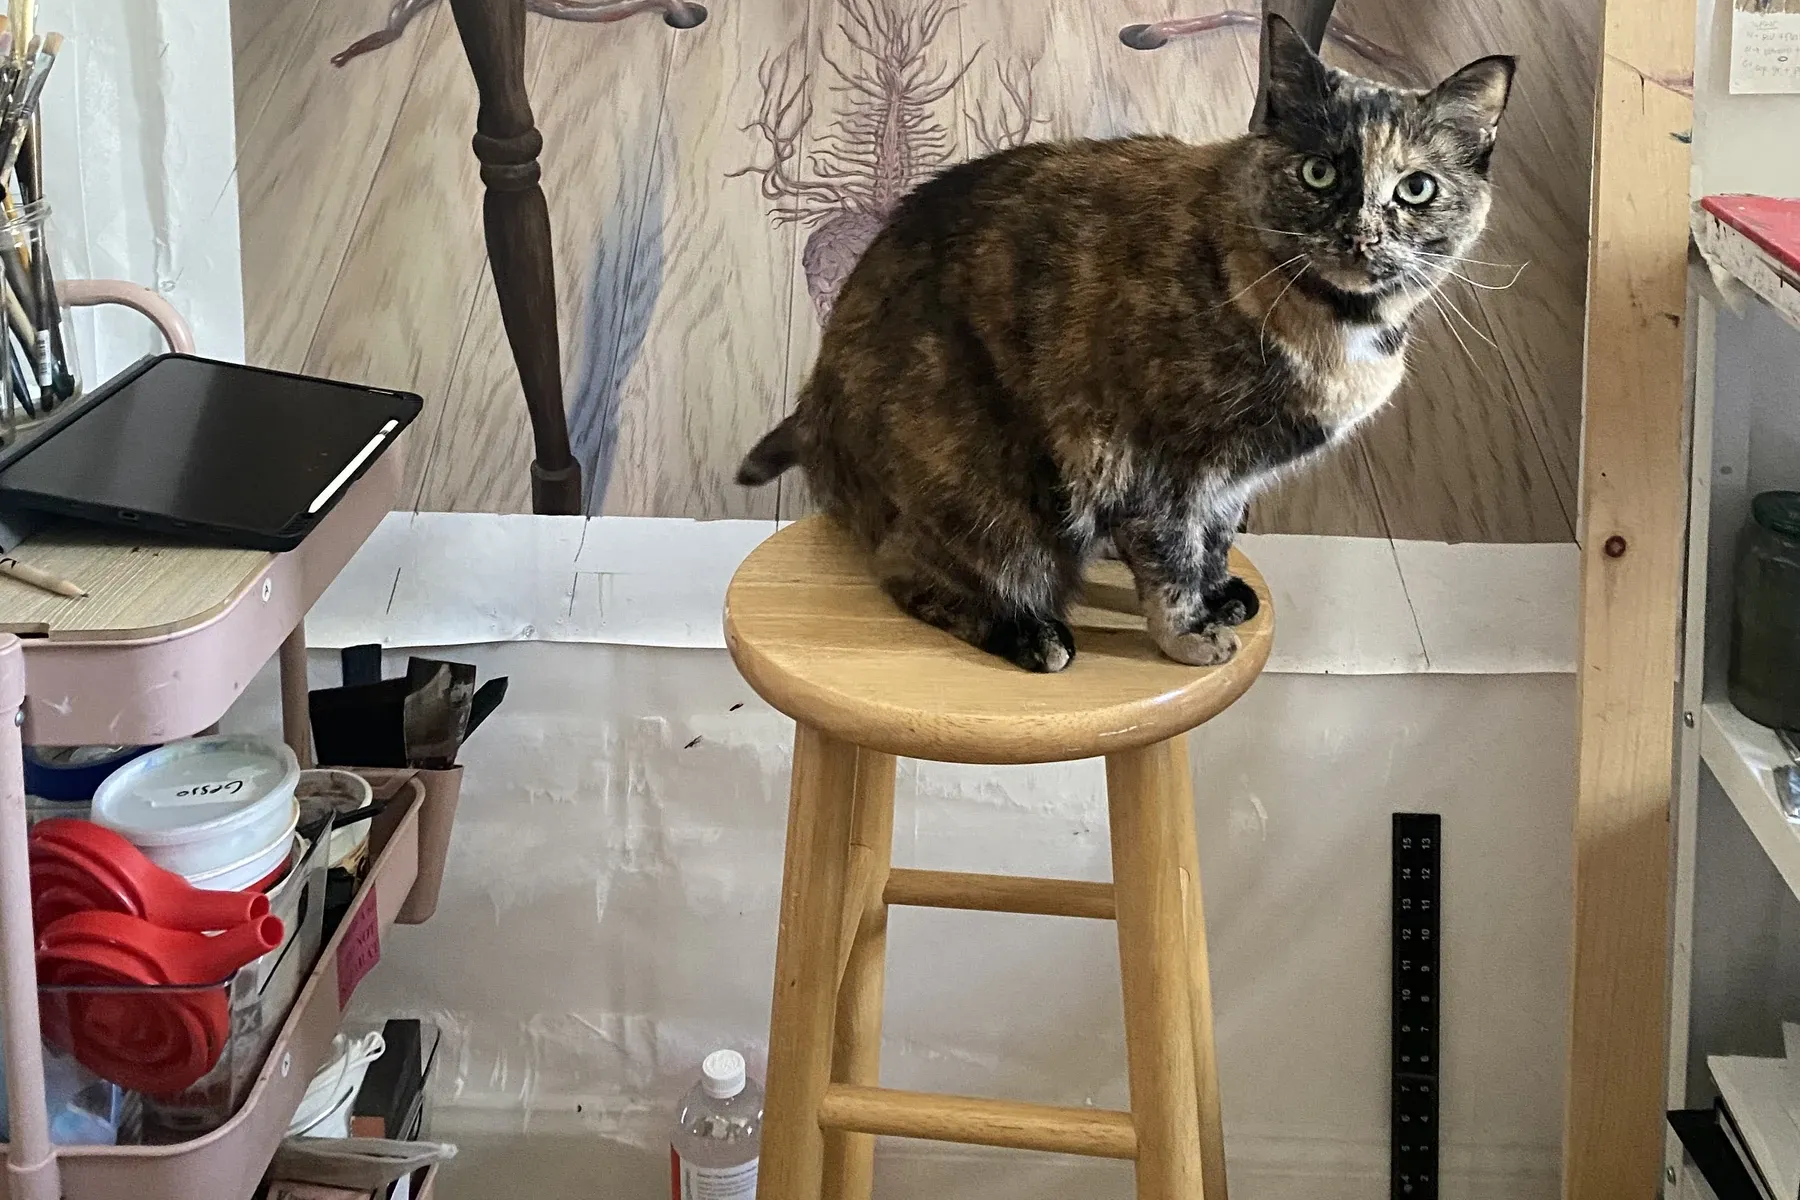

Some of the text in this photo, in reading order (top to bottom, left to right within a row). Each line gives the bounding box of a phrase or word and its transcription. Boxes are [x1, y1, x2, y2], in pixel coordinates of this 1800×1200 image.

[1402, 837, 1412, 850] 15
[1421, 837, 1431, 850] 13
[1402, 867, 1412, 880] 14
[1421, 867, 1431, 880] 12
[1402, 898, 1412, 910] 13
[1421, 899, 1431, 911] 11
[1402, 928, 1412, 941] 12
[1421, 928, 1431, 941] 10
[1402, 959, 1411, 971] 11
[1401, 988, 1411, 1001] 10
